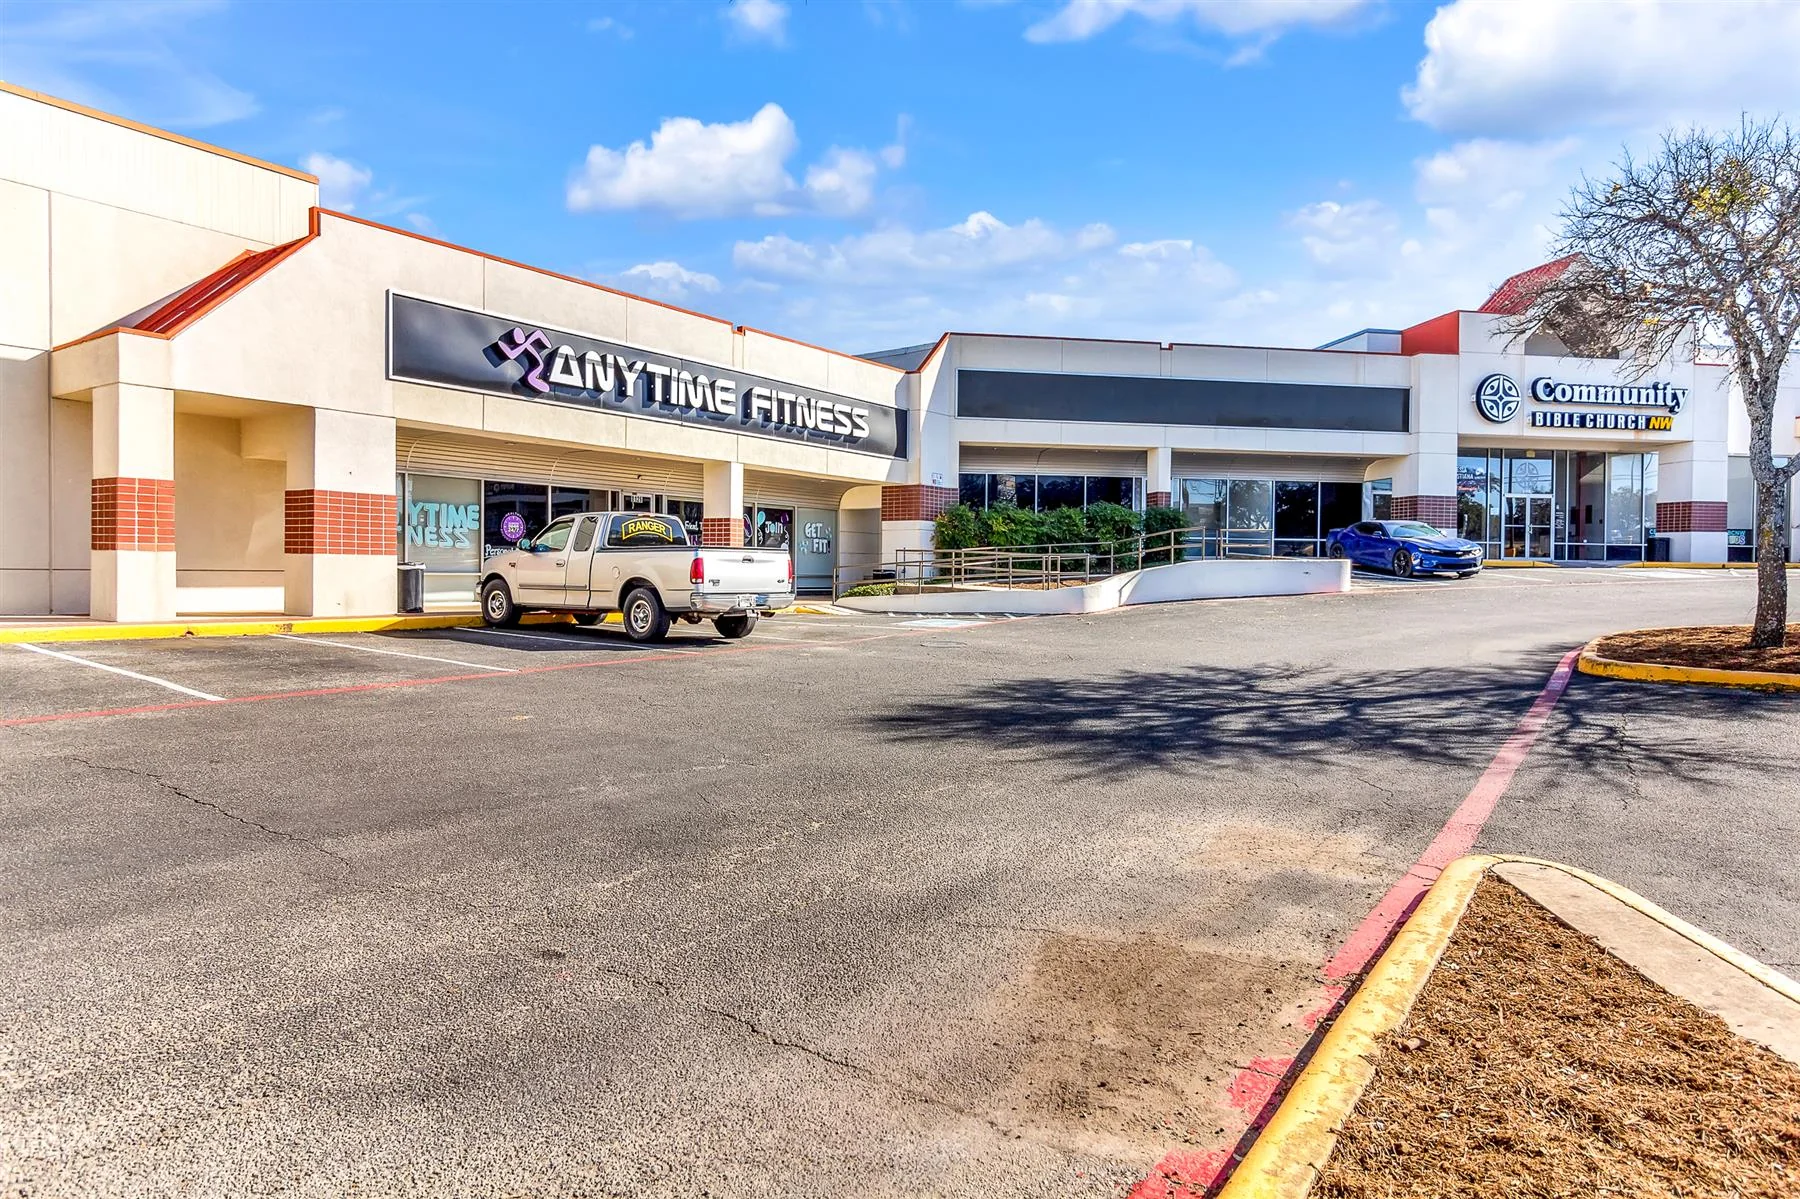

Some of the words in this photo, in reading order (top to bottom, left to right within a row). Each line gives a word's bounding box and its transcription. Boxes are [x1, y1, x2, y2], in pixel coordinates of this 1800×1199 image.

[549, 345, 736, 415] ANYTIME
[751, 385, 871, 438] FITNESS
[1534, 377, 1689, 416] Community
[1535, 412, 1580, 428] BIBLE
[1585, 413, 1646, 430] CHURCH
[1648, 416, 1674, 431] NW
[407, 501, 480, 529] YTIME
[407, 525, 473, 549] NESS
[627, 521, 667, 536] RANGER
[805, 522, 823, 538] GET
[812, 538, 831, 554] FIT!
